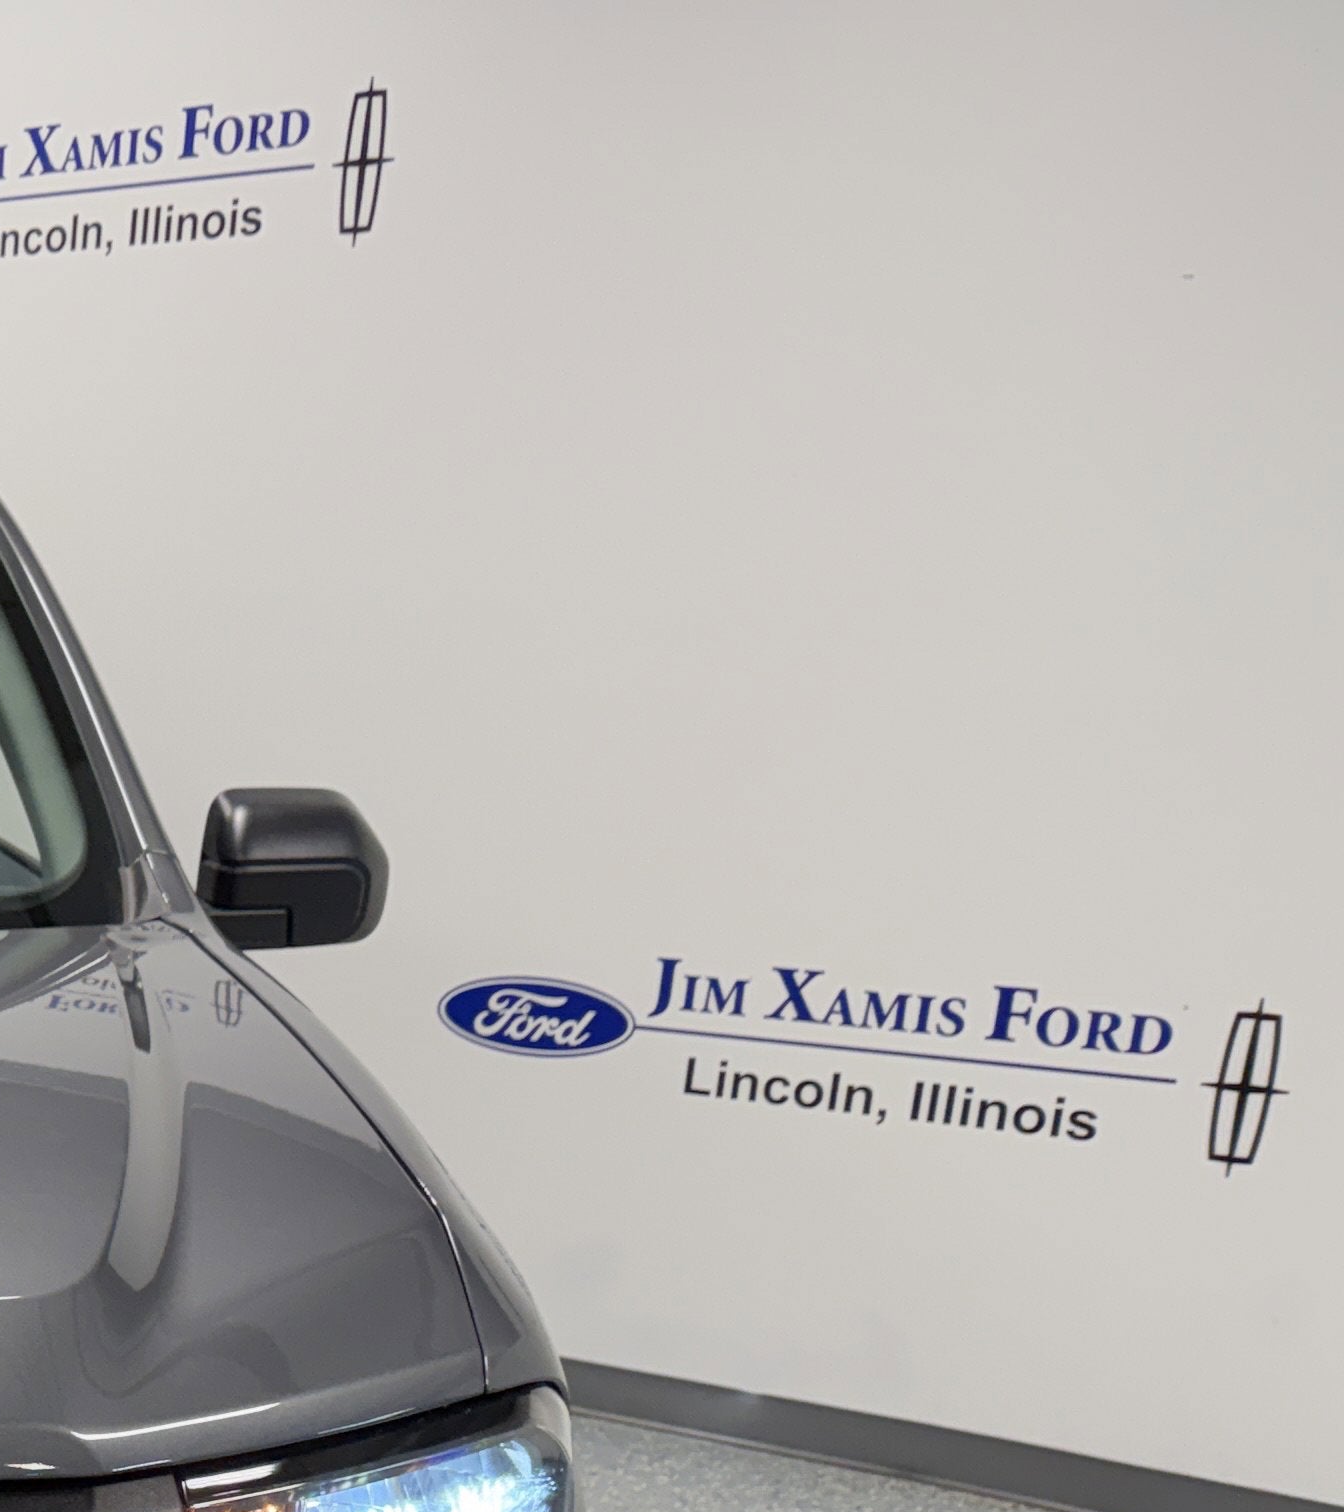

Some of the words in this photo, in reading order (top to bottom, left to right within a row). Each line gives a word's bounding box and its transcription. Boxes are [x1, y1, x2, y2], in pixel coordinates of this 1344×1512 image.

[19, 123, 164, 178] XAMIS
[177, 104, 311, 161] FORD
[128, 198, 263, 247] Illinois
[646, 956, 750, 1019] JIM
[762, 966, 968, 1039] XAMIS
[983, 984, 1174, 1056] FORD
[682, 1056, 888, 1126] Lincoln,
[908, 1081, 1099, 1142] Illinois
